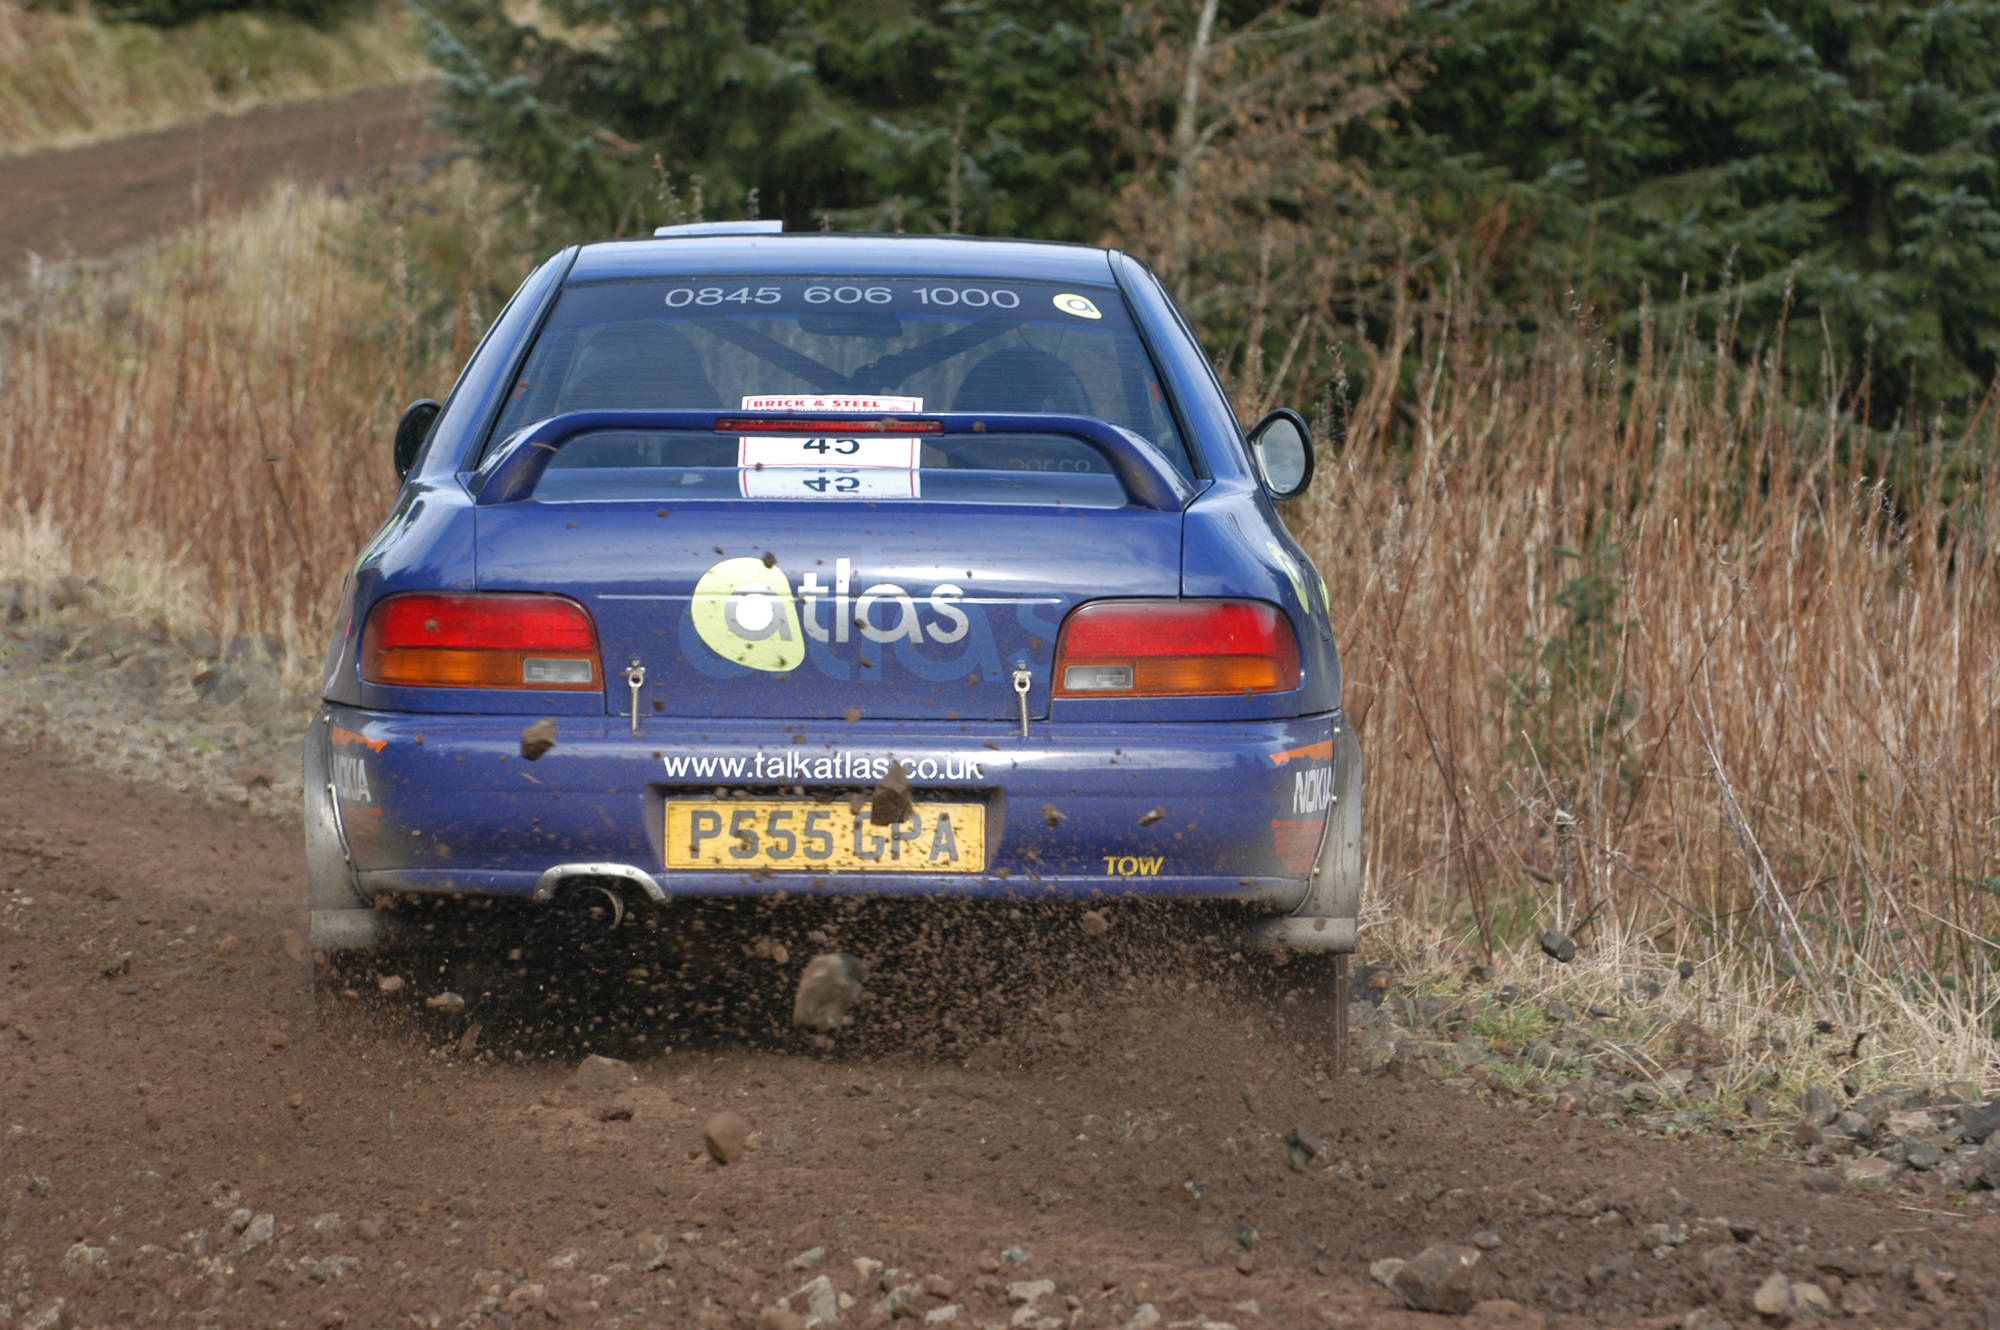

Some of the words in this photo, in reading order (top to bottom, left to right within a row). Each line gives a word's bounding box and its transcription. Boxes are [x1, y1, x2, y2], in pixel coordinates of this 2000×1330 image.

[664, 287, 783, 307] 0845
[803, 286, 893, 304] 606
[912, 287, 1020, 308] 1000
[753, 400, 805, 408] BRICK
[832, 400, 881, 408] STEEL
[802, 438, 860, 455] 45
[725, 557, 970, 643] atlas
[663, 752, 985, 780] www.talkatlasco.uk
[690, 809, 834, 860] P555
[853, 811, 959, 862] GPA
[1103, 856, 1164, 876] TOW
